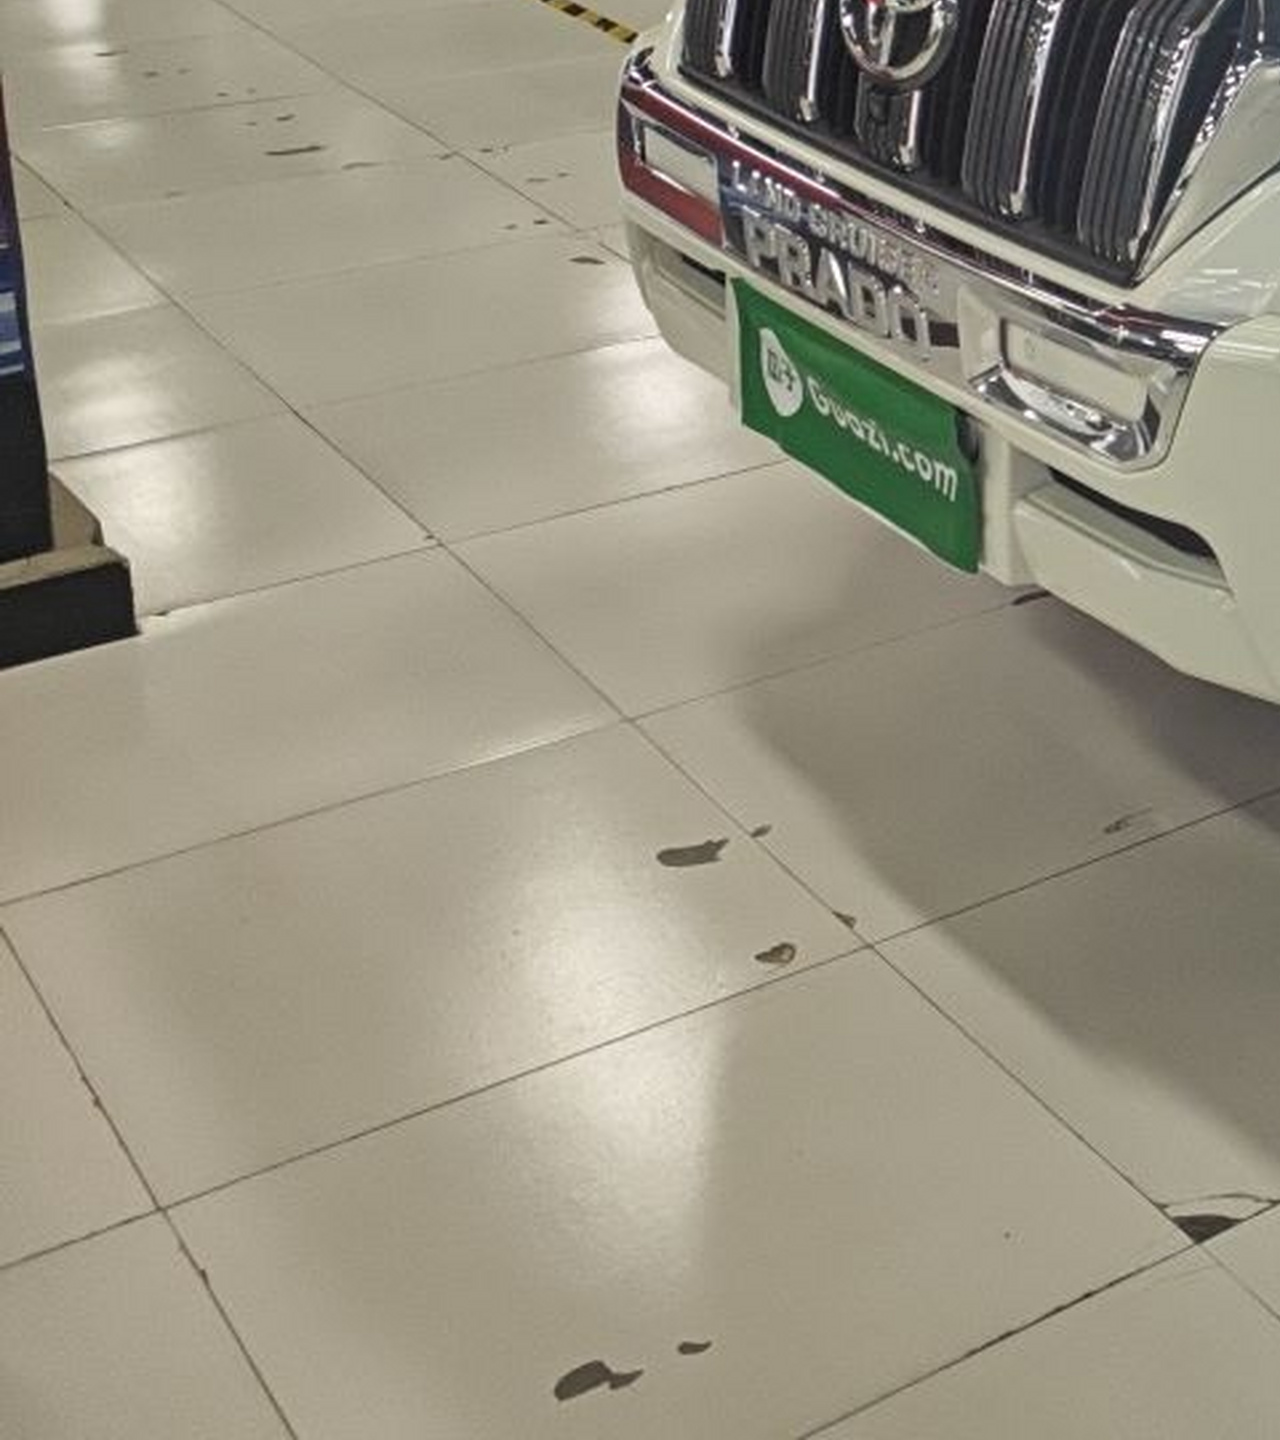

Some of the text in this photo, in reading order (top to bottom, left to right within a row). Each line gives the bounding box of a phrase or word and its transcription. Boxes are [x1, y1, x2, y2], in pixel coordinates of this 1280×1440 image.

[731, 160, 801, 223] LAND
[742, 206, 932, 360] PRADO
[806, 374, 958, 503] Guazi.com
